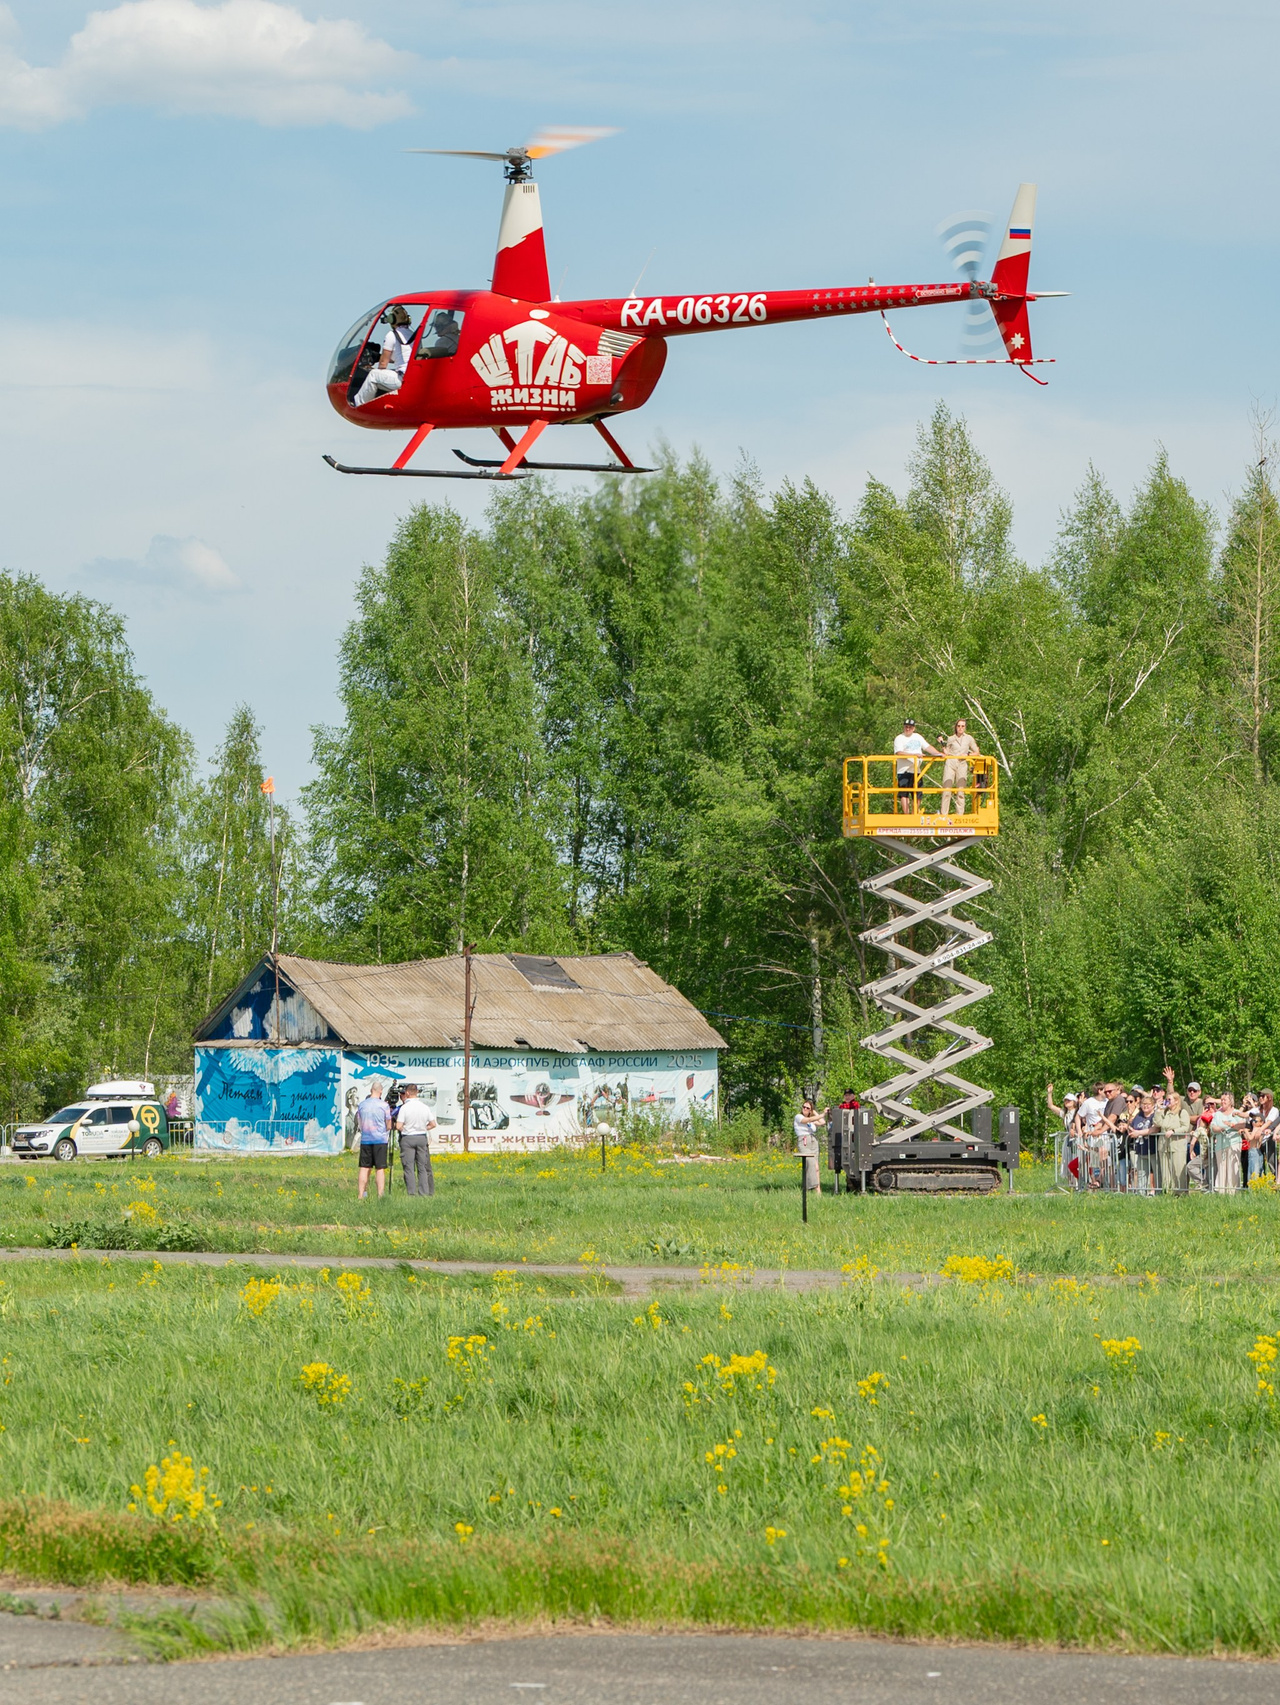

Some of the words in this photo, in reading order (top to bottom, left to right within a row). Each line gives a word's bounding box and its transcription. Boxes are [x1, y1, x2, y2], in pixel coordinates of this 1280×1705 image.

[621, 294, 767, 327] RA-06326
[470, 320, 587, 389] ШТАБ
[490, 388, 576, 406] ЖИЗНИ
[365, 1054, 399, 1067] 1935
[483, 1057, 549, 1068] АЭРОКЛУБ
[553, 1057, 605, 1069] ДОСААФ
[608, 1057, 658, 1068] РОССИИ
[667, 1054, 703, 1068] 2025
[218, 1081, 263, 1100] Летаем
[290, 1092, 328, 1108] значит
[438, 1134, 461, 1143] 90
[501, 1132, 559, 1143] живём
